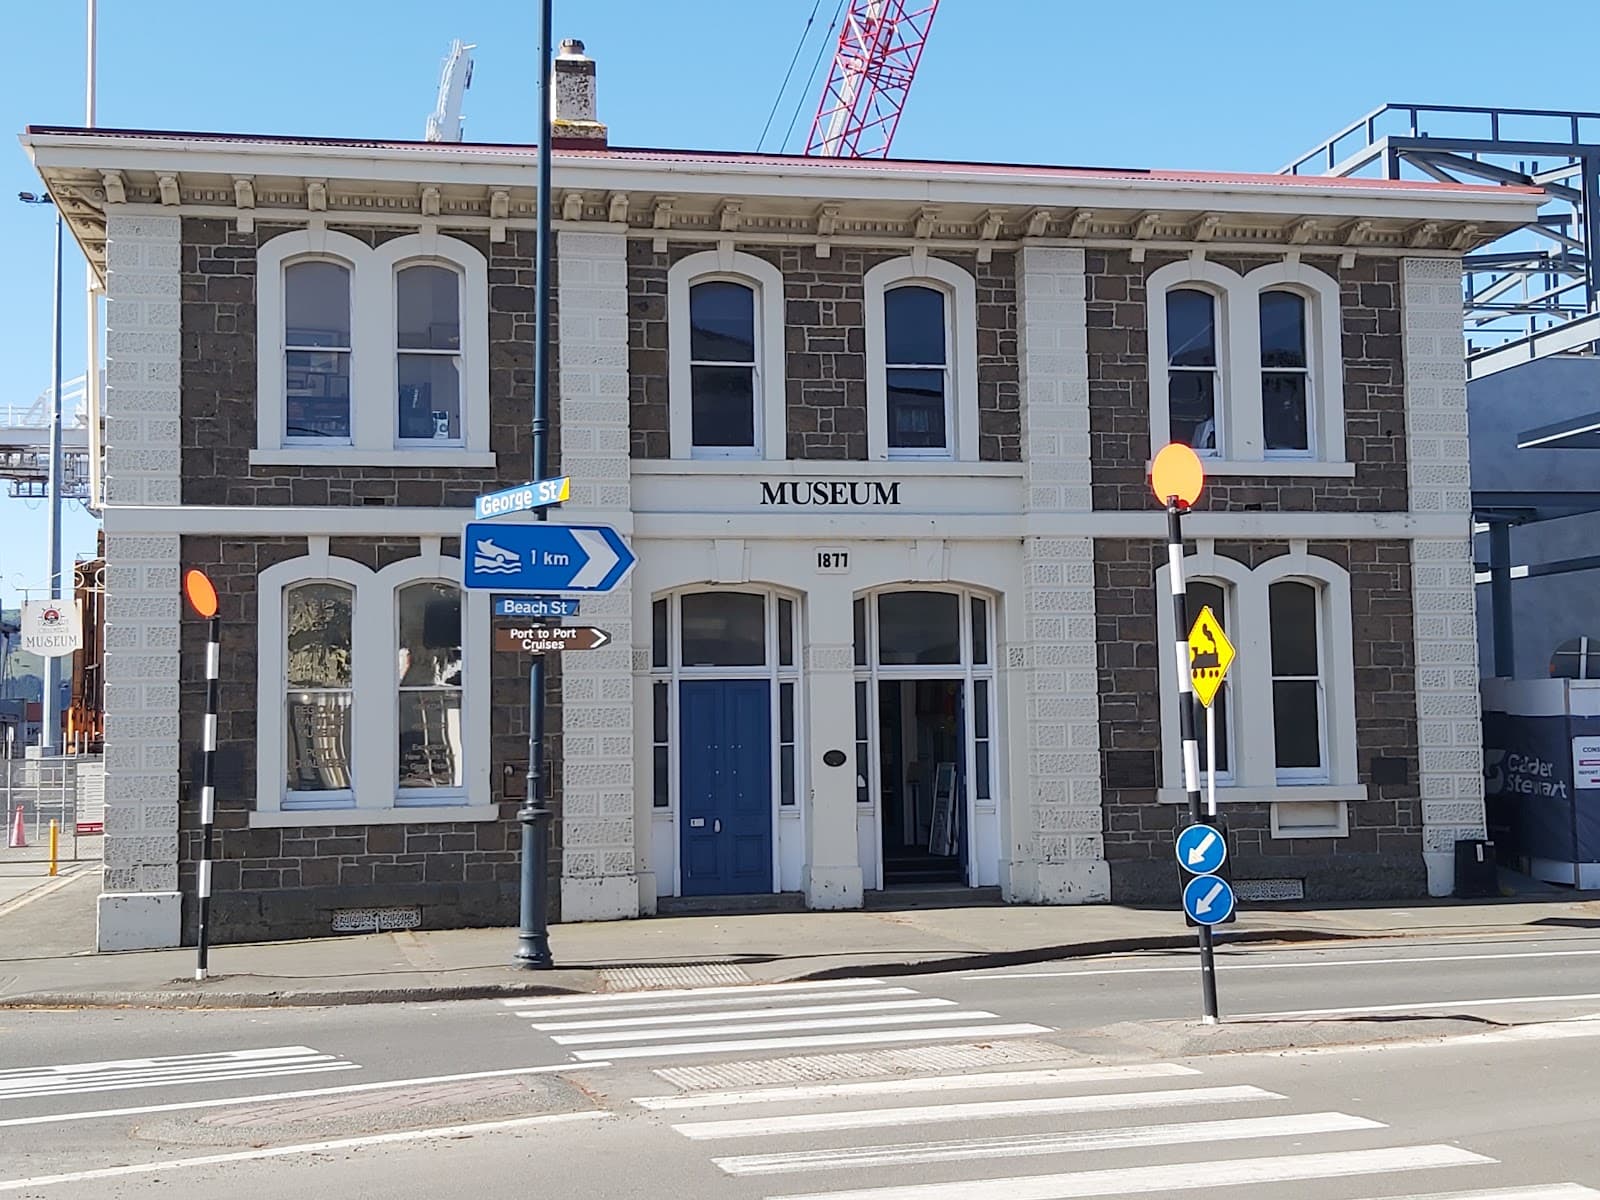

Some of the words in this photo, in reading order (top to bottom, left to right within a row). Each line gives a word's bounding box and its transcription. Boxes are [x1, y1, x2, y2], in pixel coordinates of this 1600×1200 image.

[481, 489, 532, 515] George
[539, 481, 557, 501] St
[760, 481, 901, 505] MUSEUM
[531, 550, 537, 565] 1
[544, 551, 569, 566] km
[817, 553, 848, 568] 1877
[504, 600, 547, 614] Beach
[551, 601, 568, 614] St
[510, 629, 534, 639] Port
[537, 629, 549, 638] to
[553, 628, 577, 638] Port
[26, 635, 77, 648] MUSEUM
[522, 639, 565, 650] Cruises
